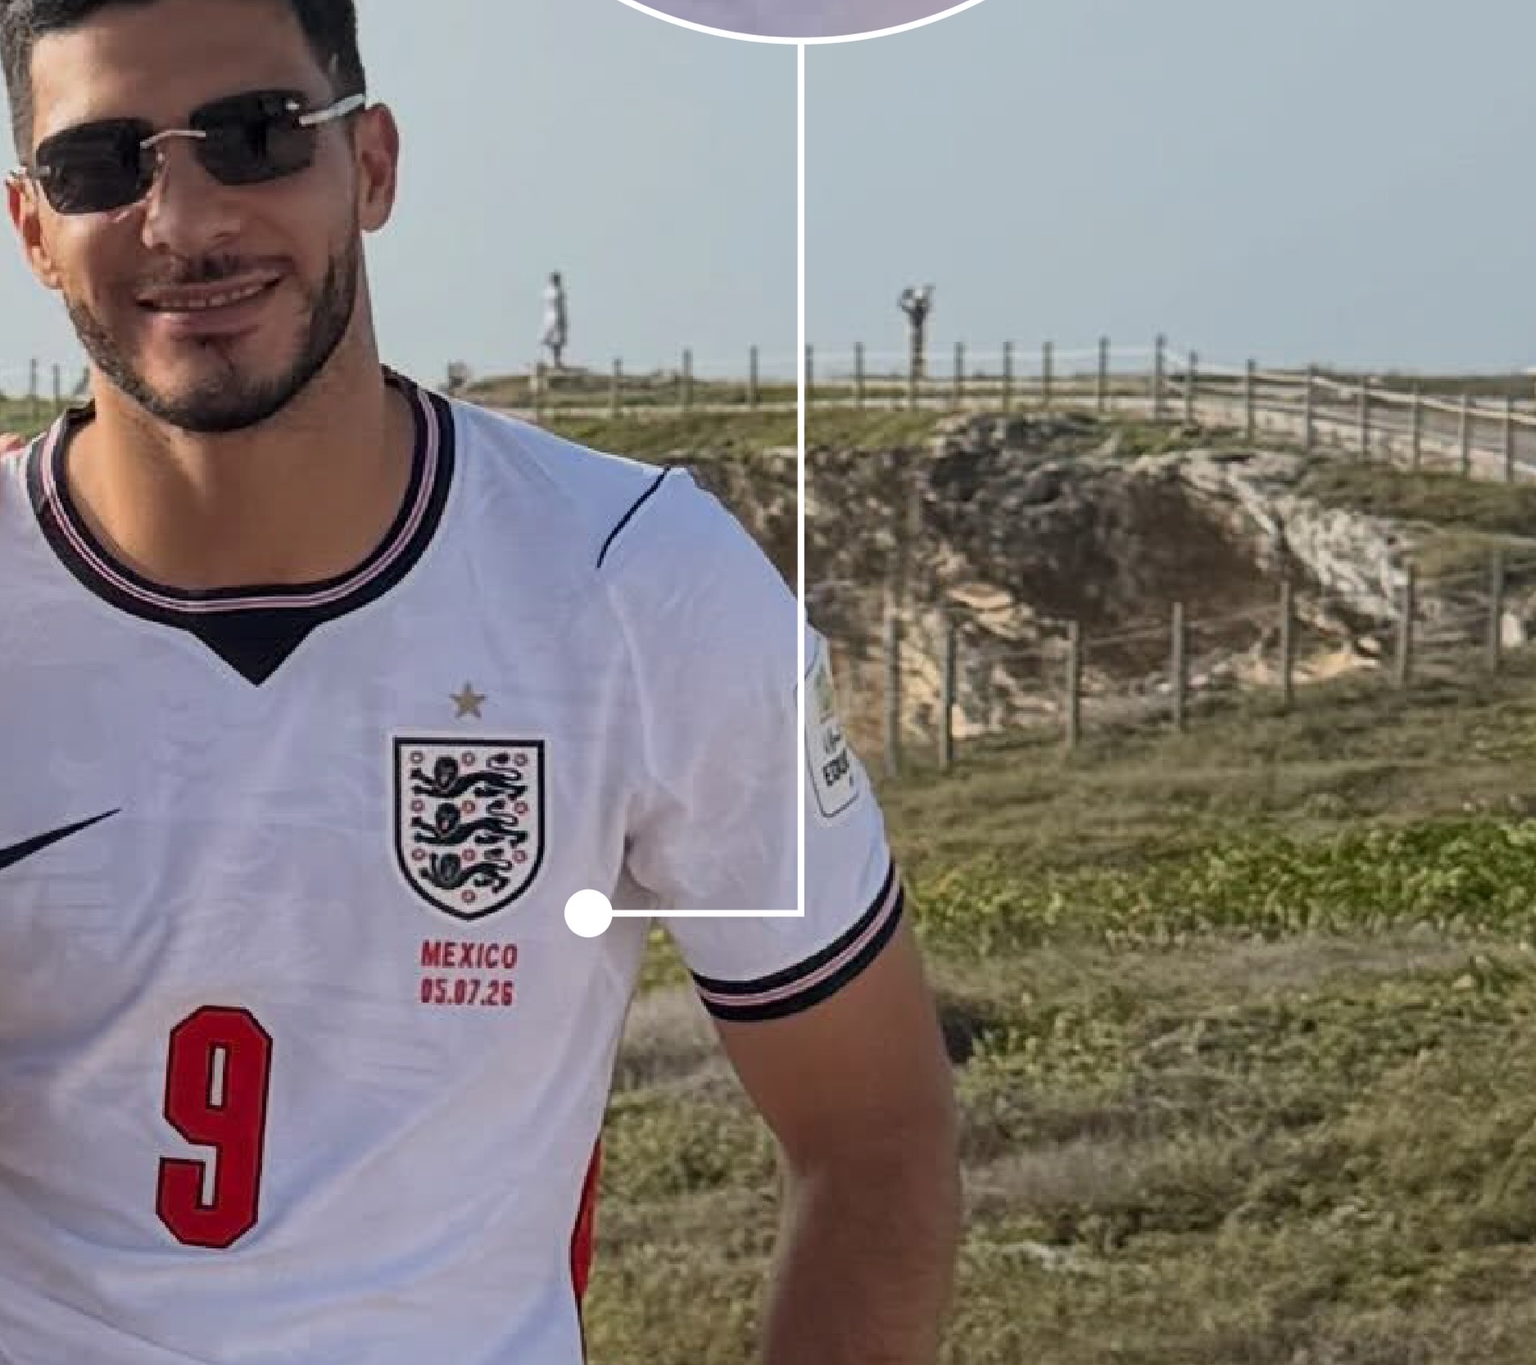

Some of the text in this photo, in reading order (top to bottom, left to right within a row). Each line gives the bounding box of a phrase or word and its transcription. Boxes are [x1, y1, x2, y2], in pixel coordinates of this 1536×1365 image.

[420, 939, 518, 969] MEXICO
[420, 978, 513, 1006] 05.07.26
[156, 1005, 272, 1249] 9
